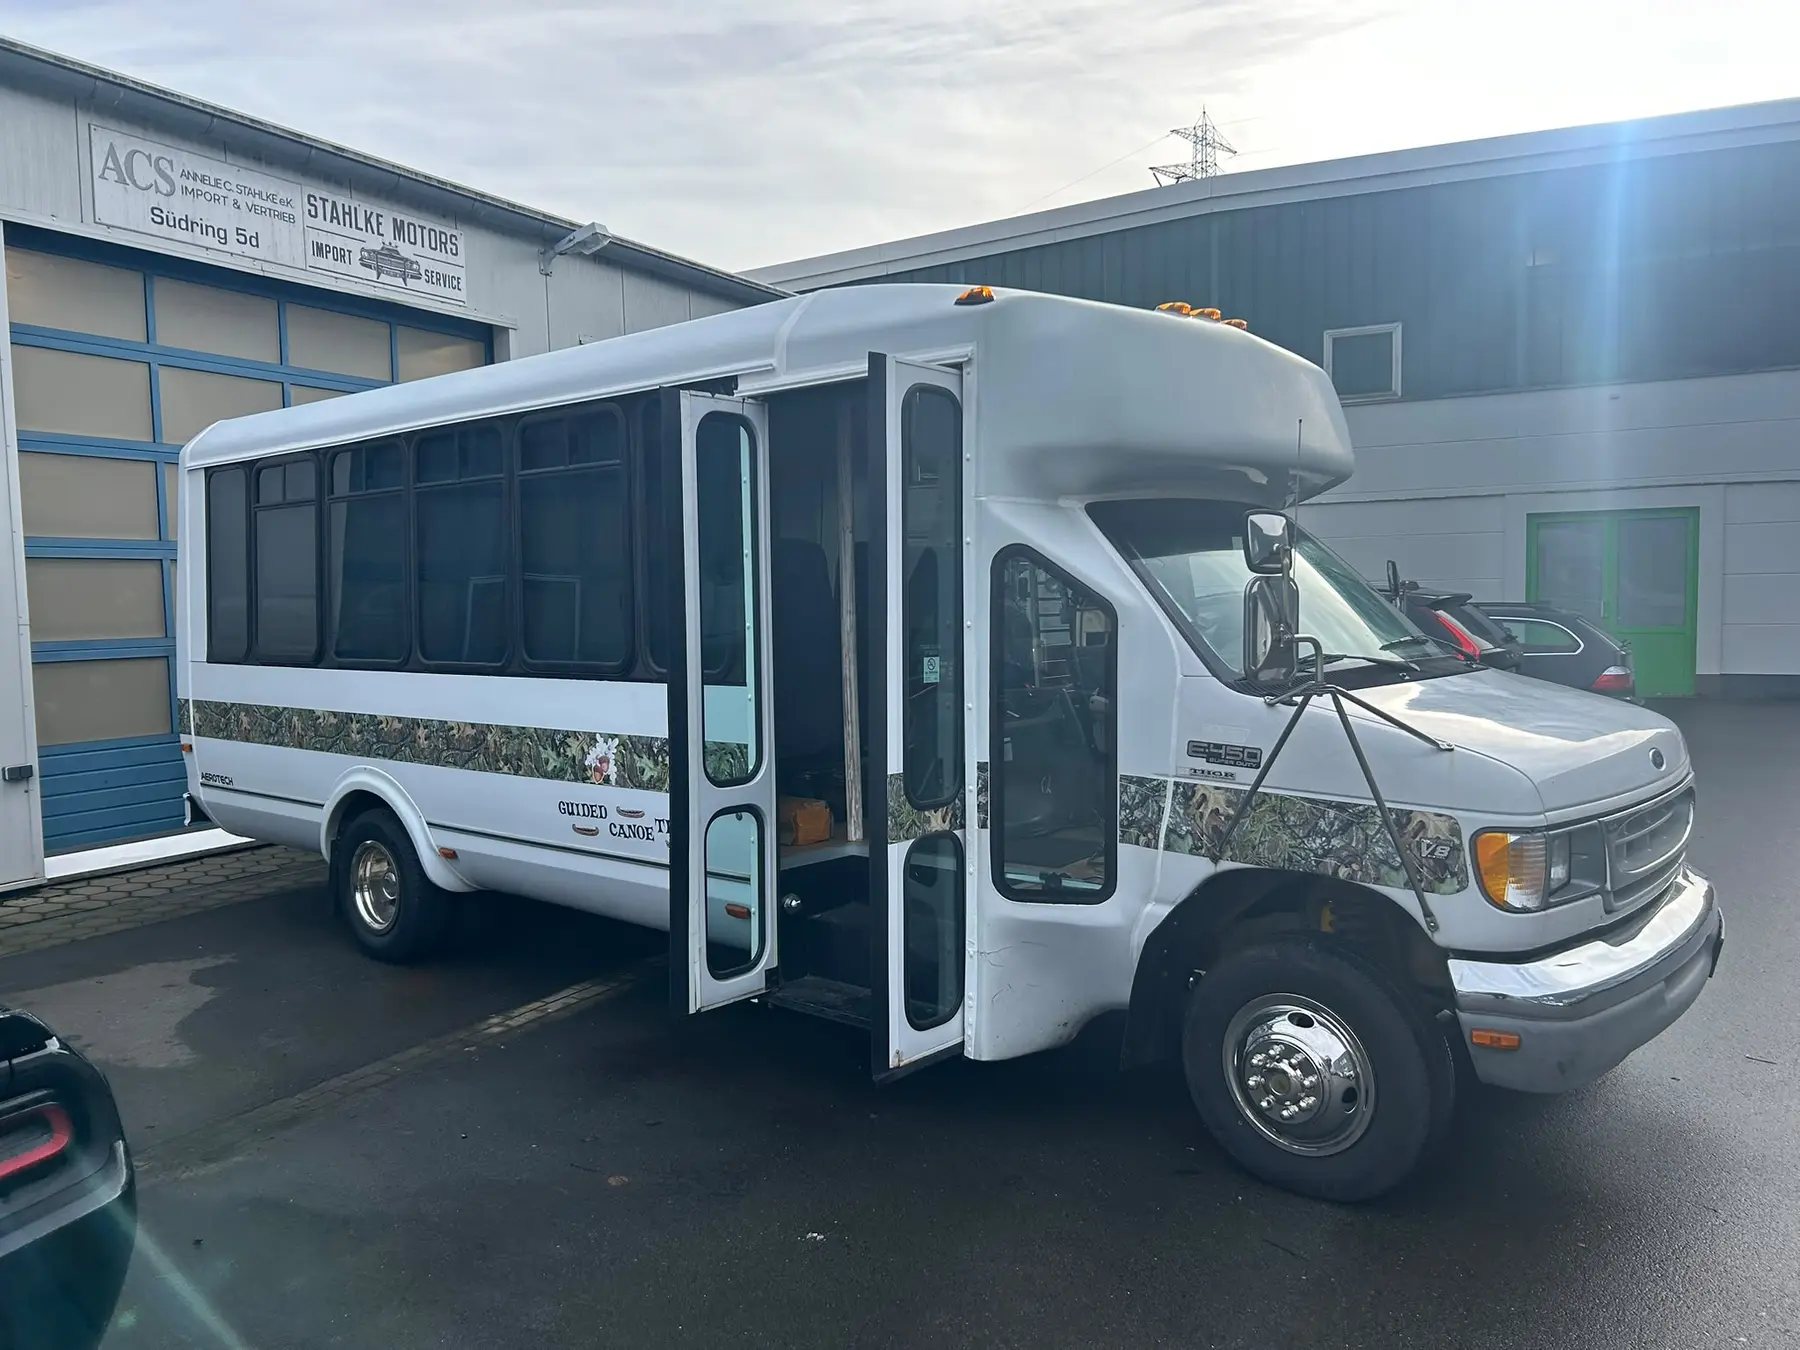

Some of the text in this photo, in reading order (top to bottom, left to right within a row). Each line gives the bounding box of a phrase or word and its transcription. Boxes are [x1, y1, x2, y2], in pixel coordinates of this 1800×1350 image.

[98, 142, 176, 197] ACS
[180, 168, 222, 190] ANNELIE
[236, 184, 278, 205] STAHLKE
[181, 184, 296, 224] IMPORT & VERTRIEB
[151, 206, 260, 249] Südring 5d
[306, 193, 459, 257] STAHLKE MOTORS
[311, 240, 353, 265] IMPORT
[424, 268, 462, 291] SERVICE
[1190, 768, 1234, 777] THOR
[1235, 760, 1257, 768] DUTY
[201, 771, 234, 786] AEROTECH
[558, 800, 608, 819] GUIDED
[609, 822, 655, 841] CANOE
[1421, 839, 1451, 858] V8
